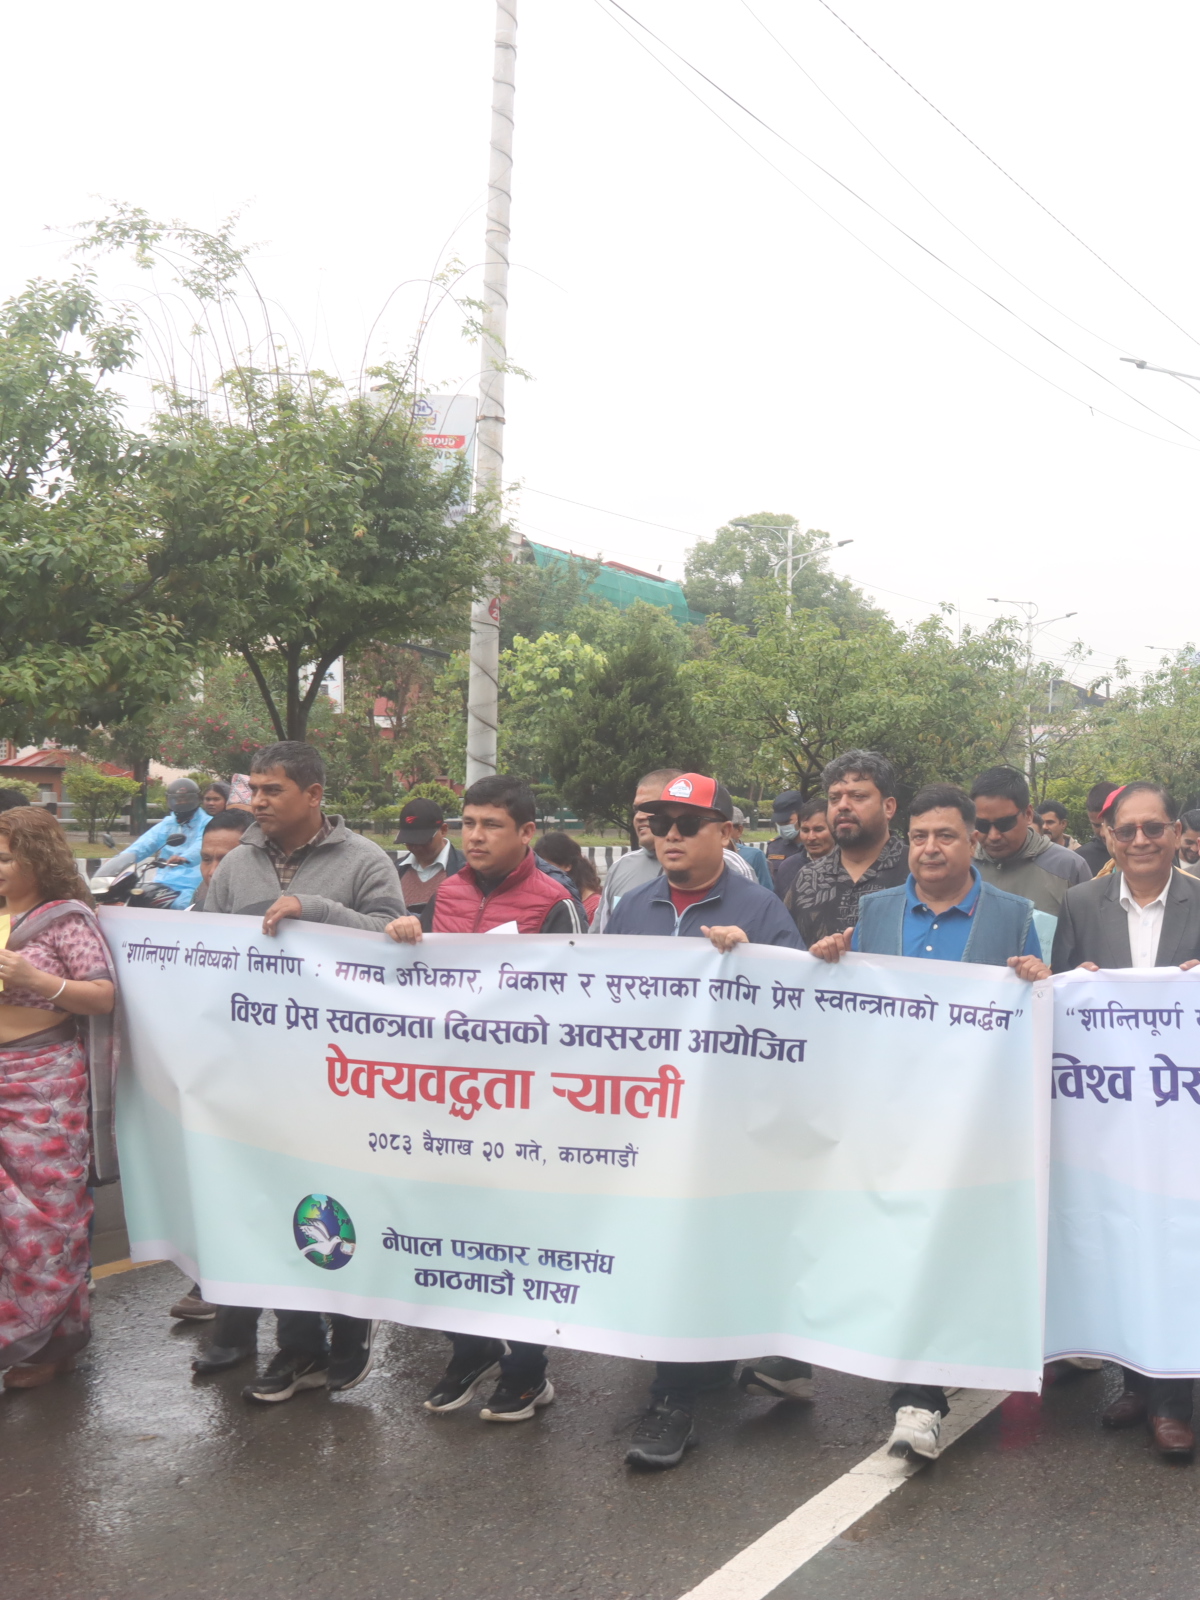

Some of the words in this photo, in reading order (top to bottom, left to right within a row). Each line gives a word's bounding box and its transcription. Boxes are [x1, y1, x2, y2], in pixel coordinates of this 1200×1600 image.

[421, 437, 456, 447] CLOUD
[185, 941, 240, 971] भविष्यको
[247, 946, 304, 976] निर्माण
[336, 962, 385, 984] मानव
[396, 961, 482, 992] अधिकार,
[499, 962, 568, 995] विकास
[578, 973, 596, 998] र
[605, 975, 701, 1003] सुरक्षाका
[709, 974, 761, 1005] लागि
[771, 980, 805, 1010] प्रेस
[814, 989, 939, 1021] स्वतन्त्रताको
[231, 992, 278, 1026] विश्व
[285, 998, 319, 1030] प्रेस
[326, 1009, 435, 1039] स्वतन्त्रता
[444, 1010, 550, 1045] दिवसको
[559, 1024, 682, 1051] अवसरमा
[688, 1024, 807, 1063] आयोजित
[1051, 1052, 1136, 1105] विश्व
[369, 1132, 412, 1155] २०८३
[423, 1129, 474, 1156] बैशाख
[483, 1142, 504, 1162] २०
[515, 1140, 546, 1166] गते,
[558, 1143, 639, 1168] काठमाडौं
[381, 1227, 443, 1257] नेपाल
[450, 1239, 530, 1266] पत्रकार
[537, 1248, 615, 1275] महासंघ
[523, 1278, 580, 1304] शाखा
